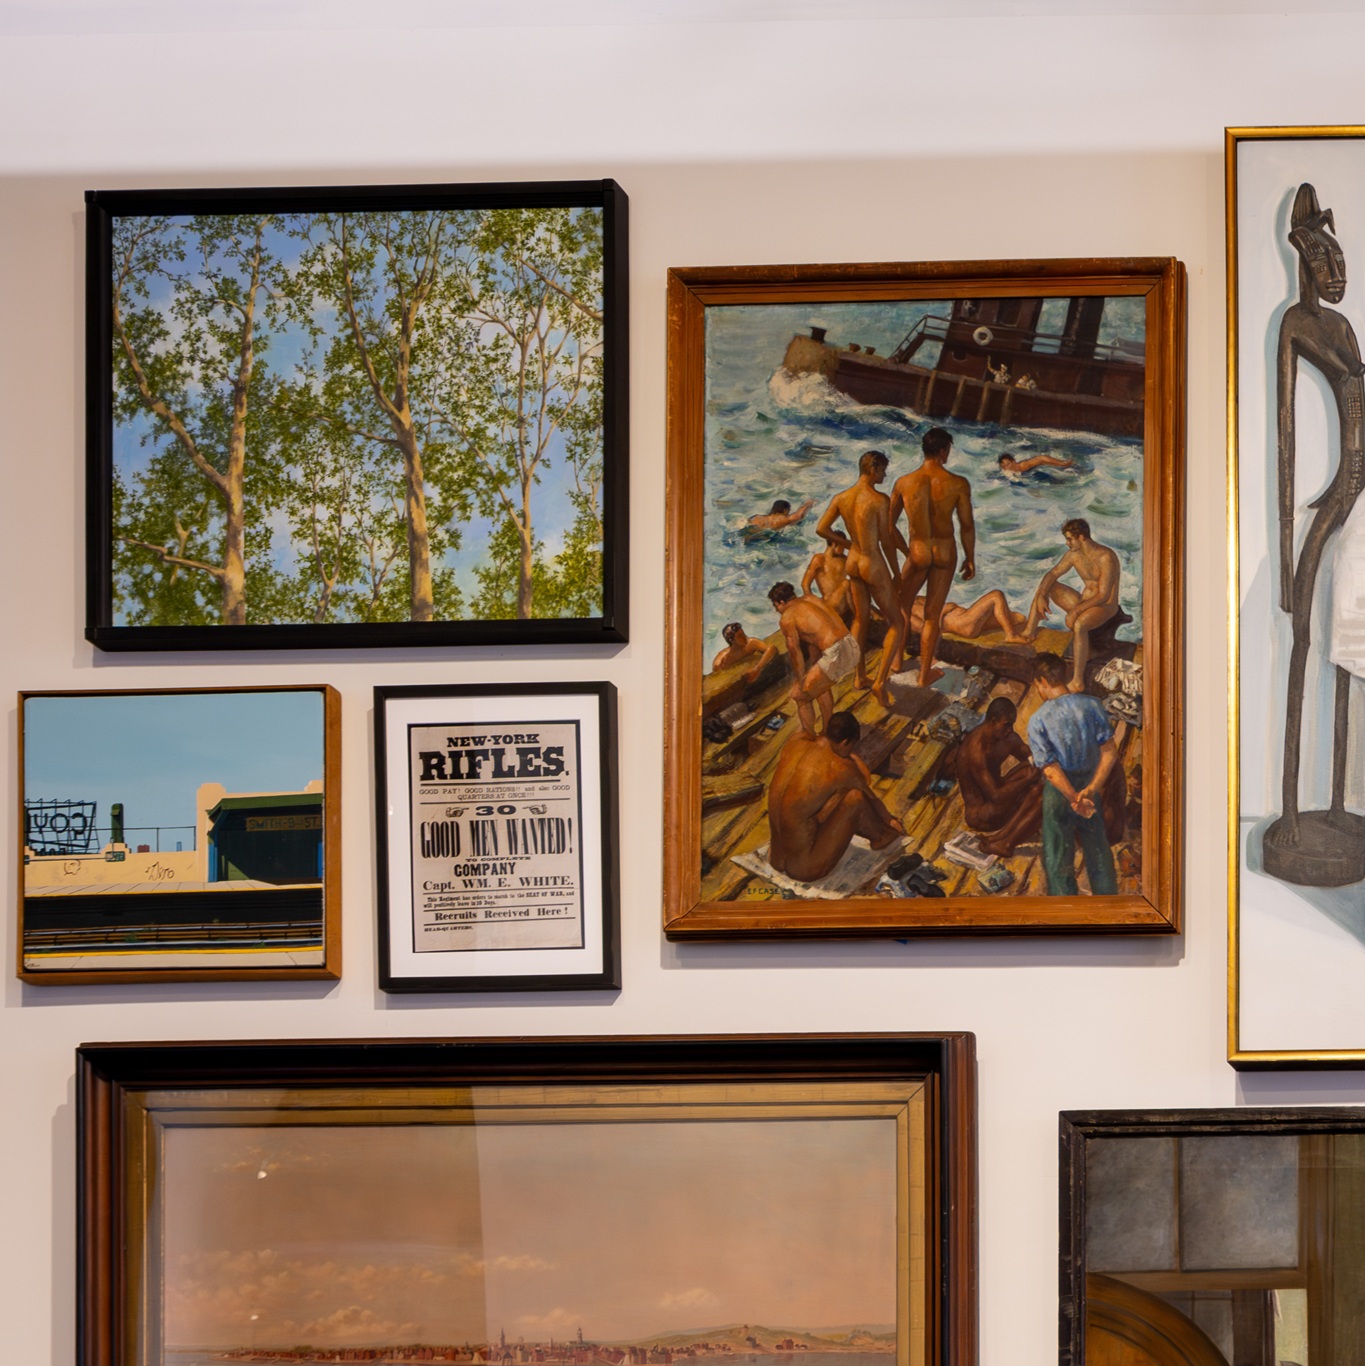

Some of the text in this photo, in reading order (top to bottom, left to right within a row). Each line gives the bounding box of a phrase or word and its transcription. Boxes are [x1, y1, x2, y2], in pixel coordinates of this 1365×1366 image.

[447, 733, 540, 748] NEW-YORK
[419, 746, 570, 781] RIFLES.
[475, 804, 517, 816] 30
[420, 817, 573, 859] GOOD MEN WANTED!
[454, 862, 516, 877] COMPANY
[422, 875, 574, 893] Capt. WM. E. WHITE.
[435, 910, 477, 921] Recruits
[484, 908, 530, 919] Received
